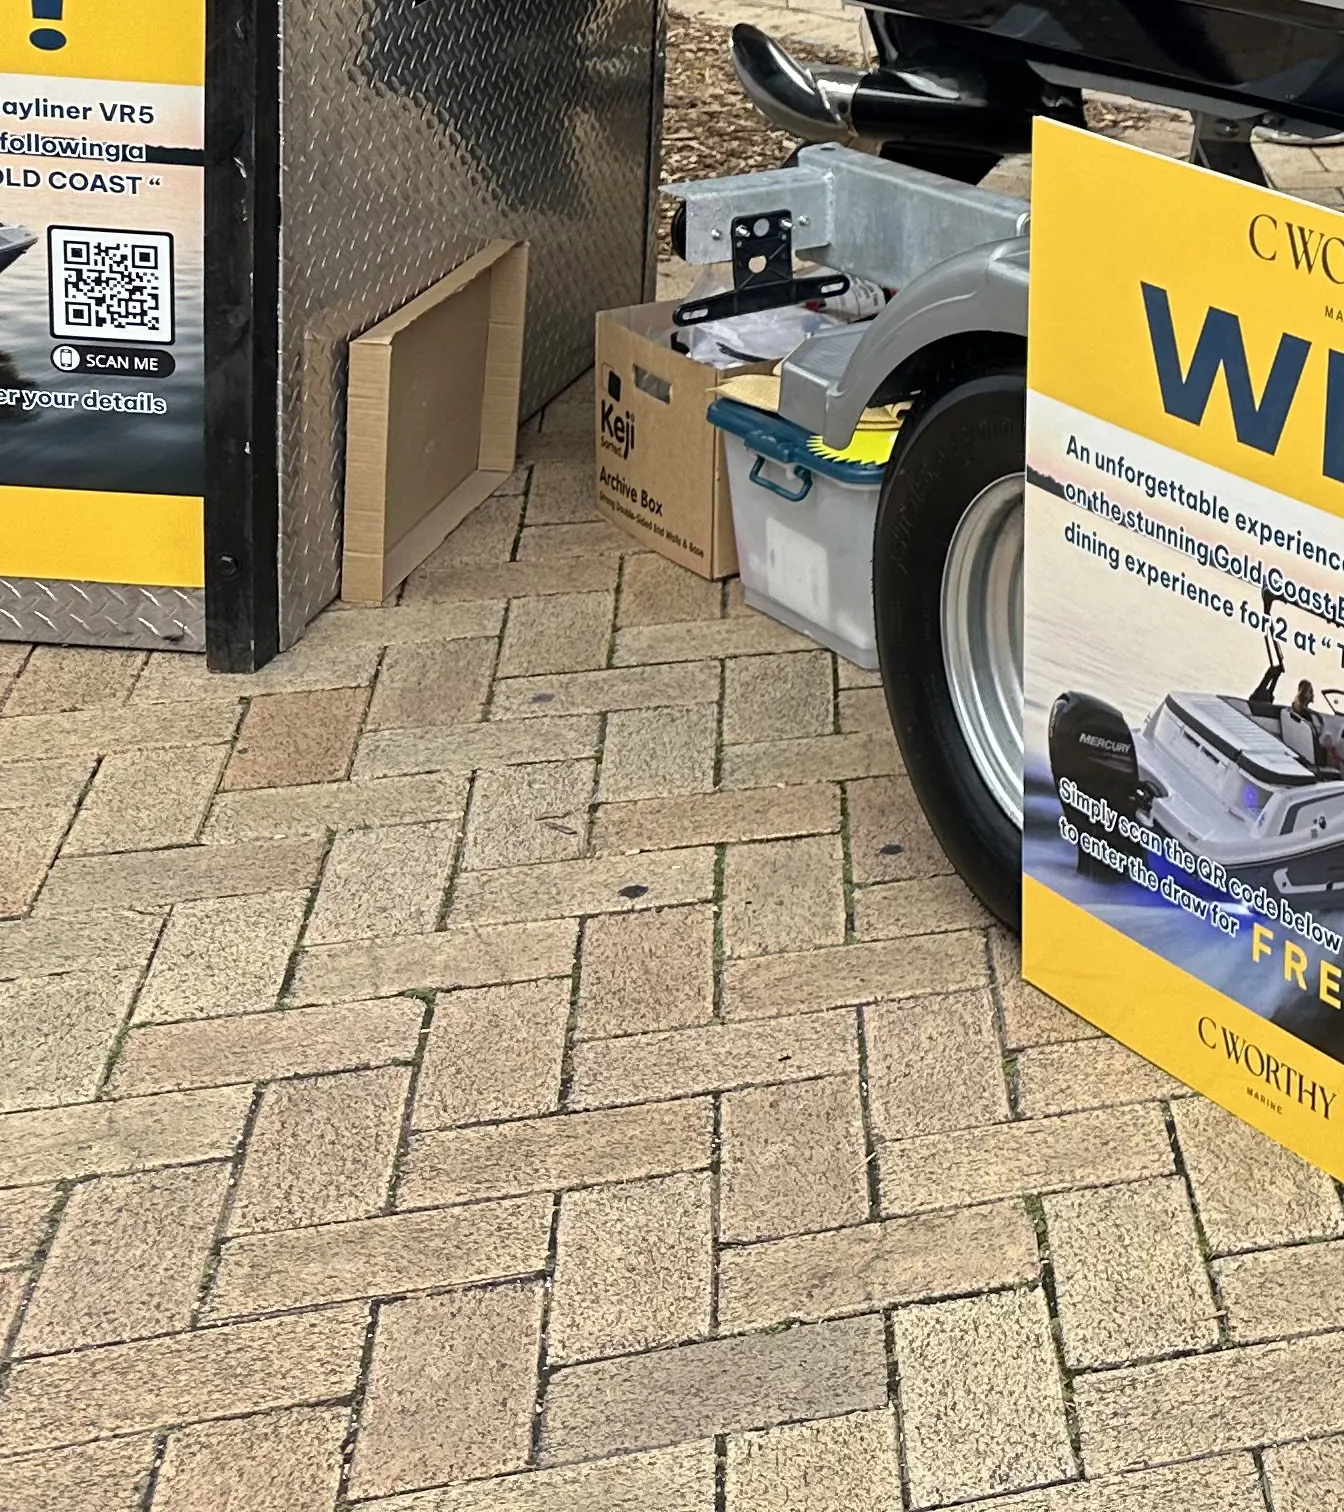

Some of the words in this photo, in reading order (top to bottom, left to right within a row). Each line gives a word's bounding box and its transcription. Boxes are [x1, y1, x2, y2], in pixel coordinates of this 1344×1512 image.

[2, 98, 93, 120] ayliner
[99, 102, 154, 124] VR5
[0, 132, 120, 162] following
[128, 144, 145, 160] a
[48, 171, 142, 194] COAST
[1249, 214, 1277, 261] C
[86, 354, 129, 369] SCAN
[134, 357, 159, 371] ME
[22, 391, 78, 410] your
[82, 390, 167, 414] details
[601, 399, 635, 459] Keji
[600, 466, 638, 503] Archive
[640, 489, 664, 517] Box
[1066, 435, 1090, 464] An
[1095, 452, 1229, 523] unforgettable
[1065, 483, 1089, 507] on
[1092, 491, 1122, 521] the
[1127, 510, 1209, 565] stunning
[1214, 544, 1263, 585] Gold
[1268, 568, 1334, 615] Coast
[1064, 522, 1120, 570] dining
[1125, 554, 1234, 617] experience
[1240, 601, 1269, 631] for
[1275, 617, 1288, 642] 2
[1294, 630, 1316, 655] at
[1079, 732, 1131, 754] MERCURY
[1059, 778, 1117, 830] Simply
[1119, 816, 1162, 856] scan
[1164, 836, 1195, 874] the
[1197, 856, 1227, 892] QR
[1229, 877, 1278, 918] code
[1280, 899, 1343, 954] below
[1059, 816, 1078, 844] to
[1080, 834, 1127, 873] enter
[1128, 857, 1158, 890] the
[1160, 875, 1209, 922] draw
[1211, 903, 1239, 937] for
[1198, 1016, 1217, 1050] C
[1221, 1026, 1337, 1120] WORTHY
[1246, 1087, 1283, 1115] MARINE
